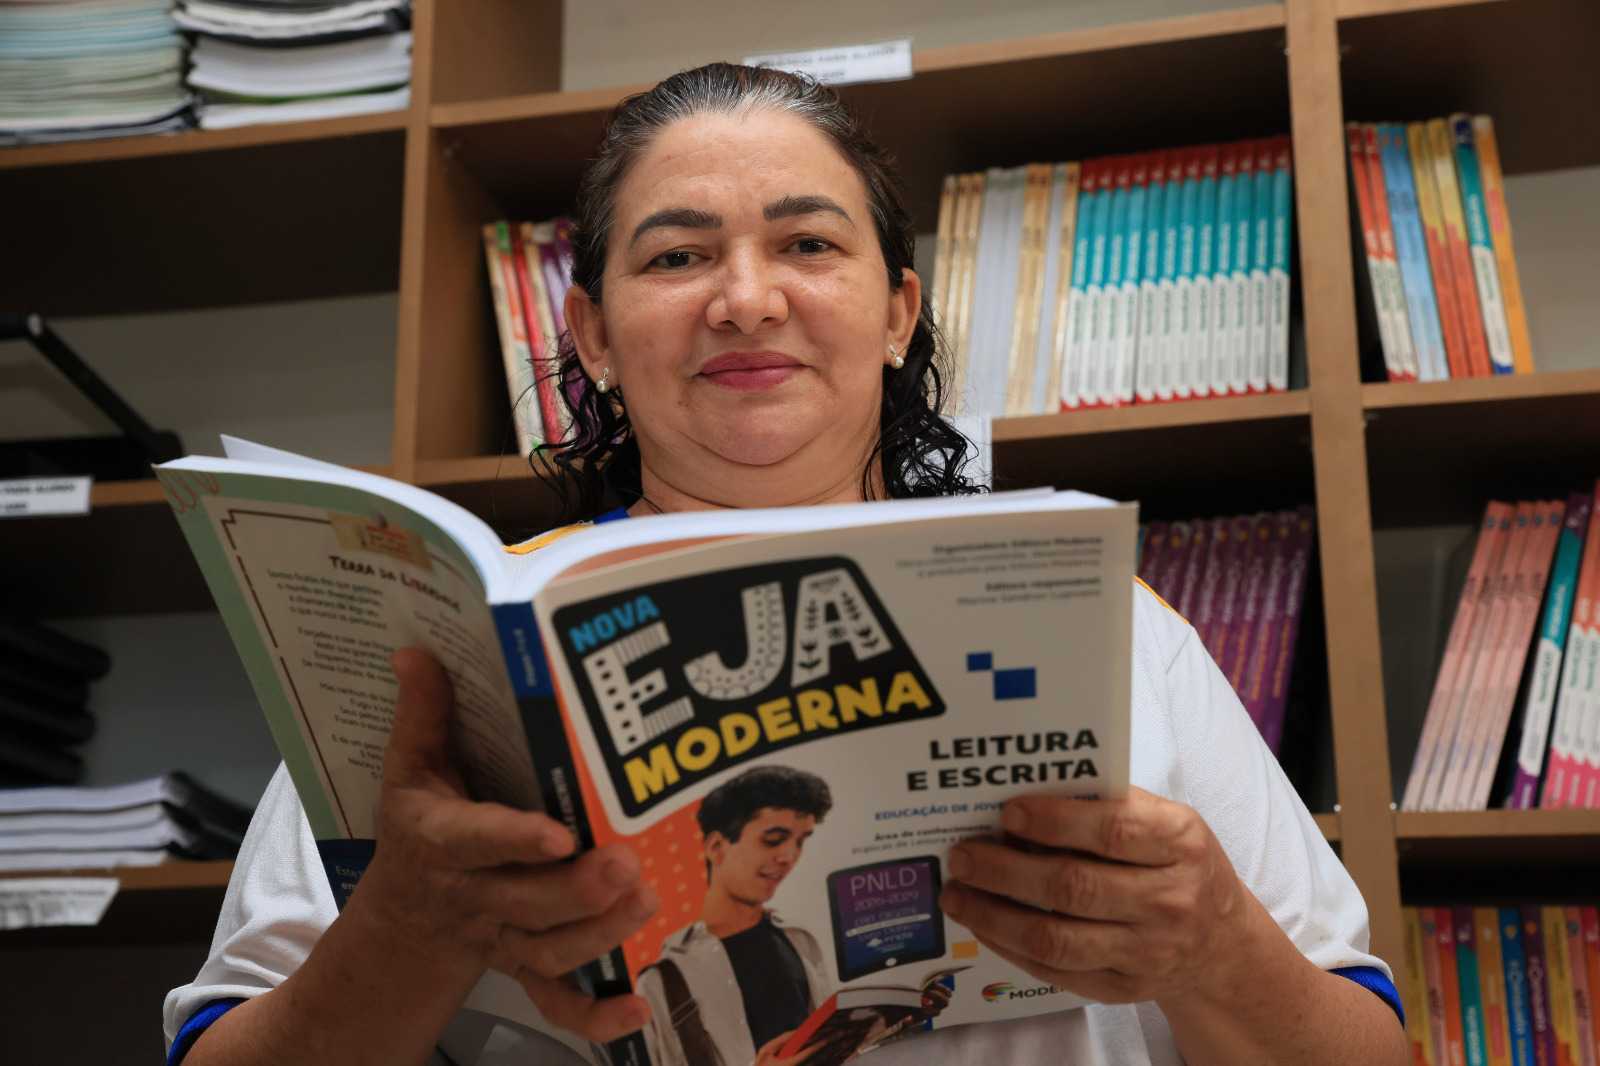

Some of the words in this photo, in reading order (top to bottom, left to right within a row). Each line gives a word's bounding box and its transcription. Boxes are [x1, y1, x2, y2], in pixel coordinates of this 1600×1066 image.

[329, 555, 375, 576] TERRA
[569, 595, 660, 653] NOVA
[583, 568, 893, 757] EJA
[623, 671, 932, 804] MODERNA
[930, 728, 1099, 760] LEITURA
[907, 771, 928, 792] E
[938, 758, 1099, 789] ESCRITA
[875, 802, 949, 821] EDUCAÇÃO
[952, 803, 970, 813] DE
[973, 801, 1005, 812] JOVE
[901, 828, 915, 838] de
[850, 866, 918, 897] PNLD
[1008, 985, 1064, 1001] MODE
